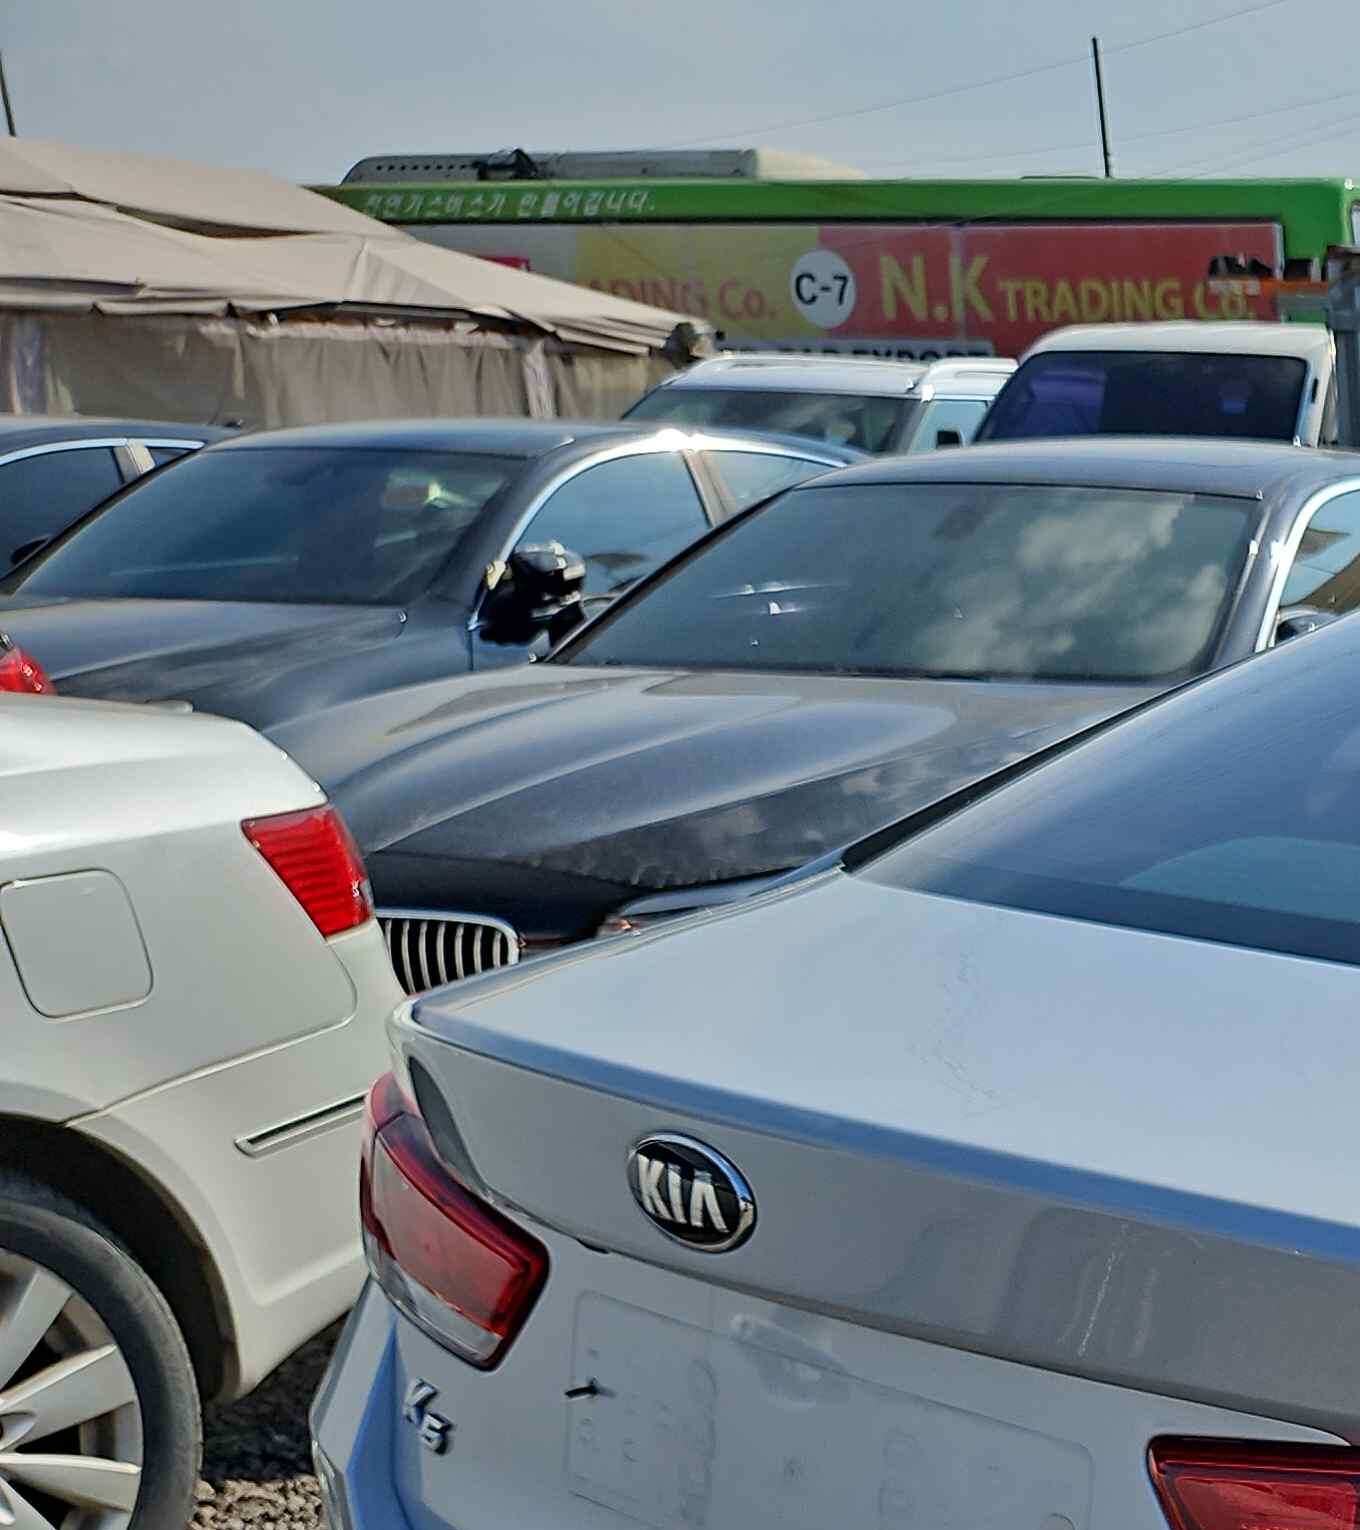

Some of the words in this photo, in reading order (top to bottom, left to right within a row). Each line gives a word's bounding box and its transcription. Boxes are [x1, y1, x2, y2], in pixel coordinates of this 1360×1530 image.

[795, 272, 849, 306] C-7
[878, 254, 994, 322] N.K
[1000, 276, 1187, 322] TRADING
[635, 1152, 730, 1234] KIA
